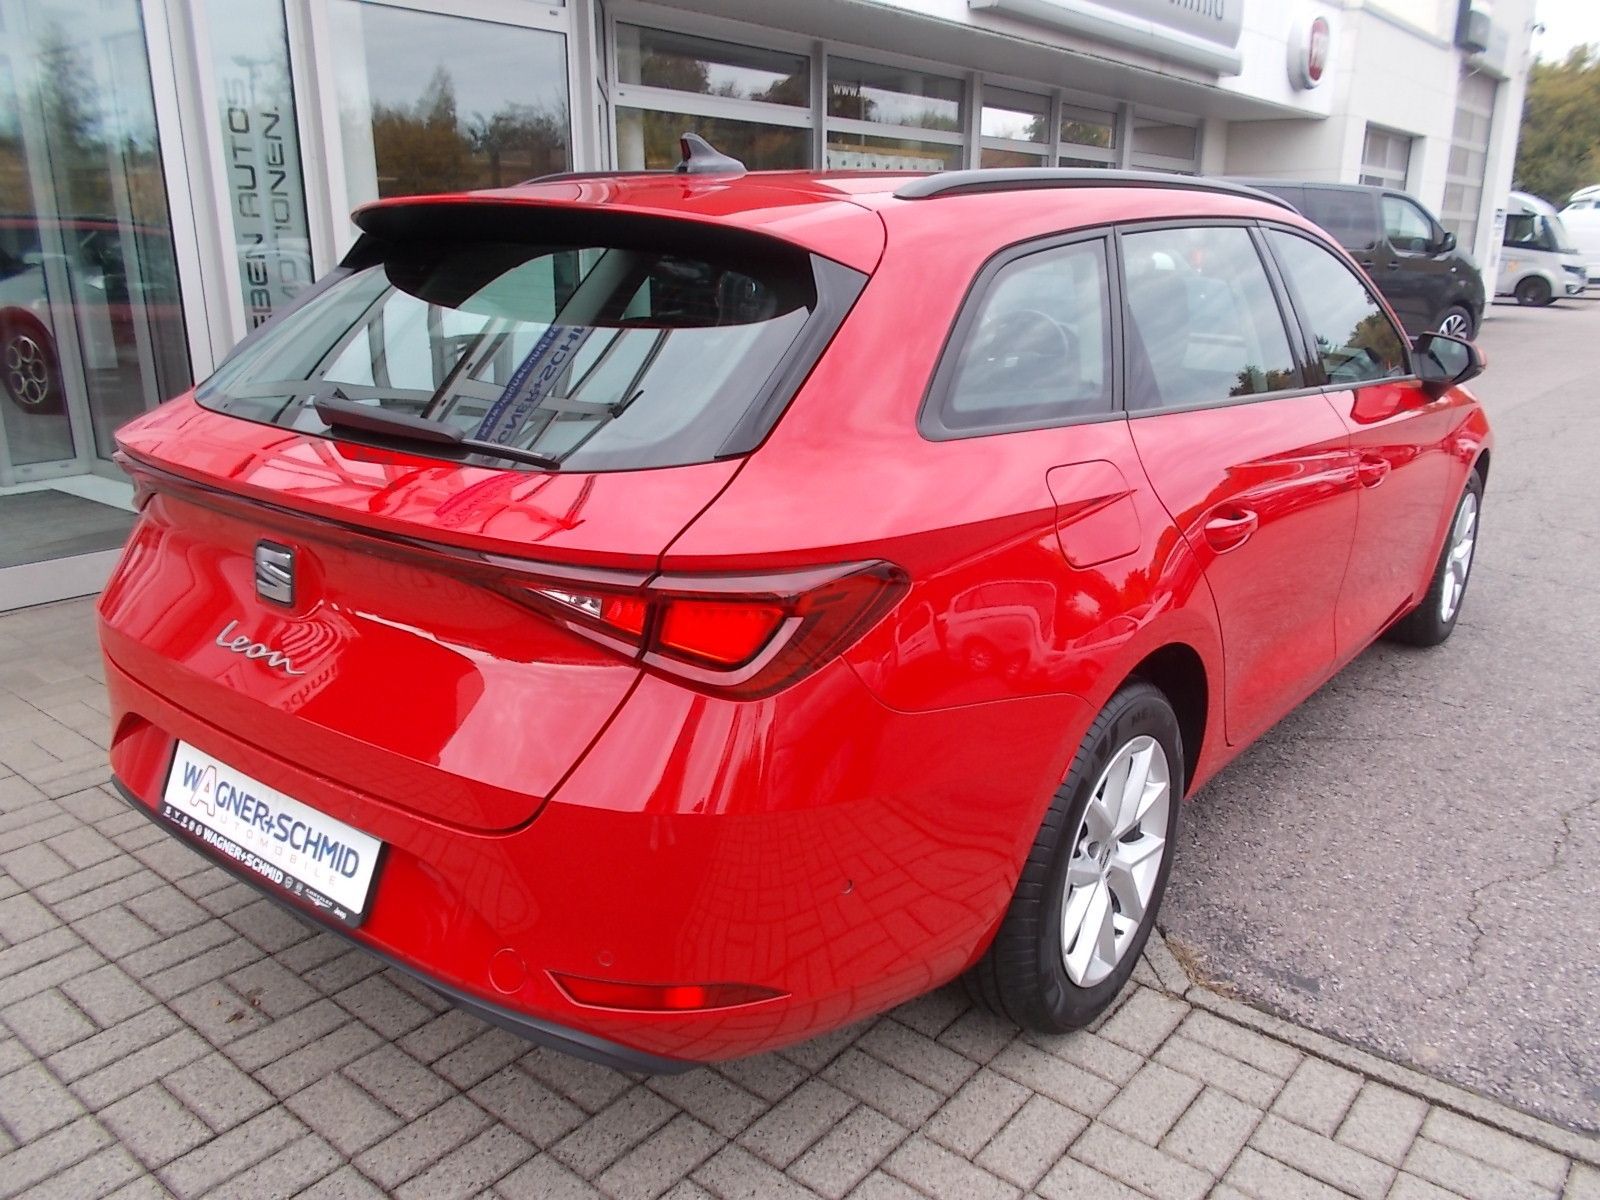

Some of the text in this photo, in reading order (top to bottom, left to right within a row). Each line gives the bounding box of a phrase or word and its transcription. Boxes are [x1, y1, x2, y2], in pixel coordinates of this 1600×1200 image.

[226, 78, 261, 218] AUTOS
[215, 619, 306, 675] Leon
[183, 760, 360, 879] WAGNER+SCHMID
[203, 827, 284, 885] WAGNER+SCHMID
